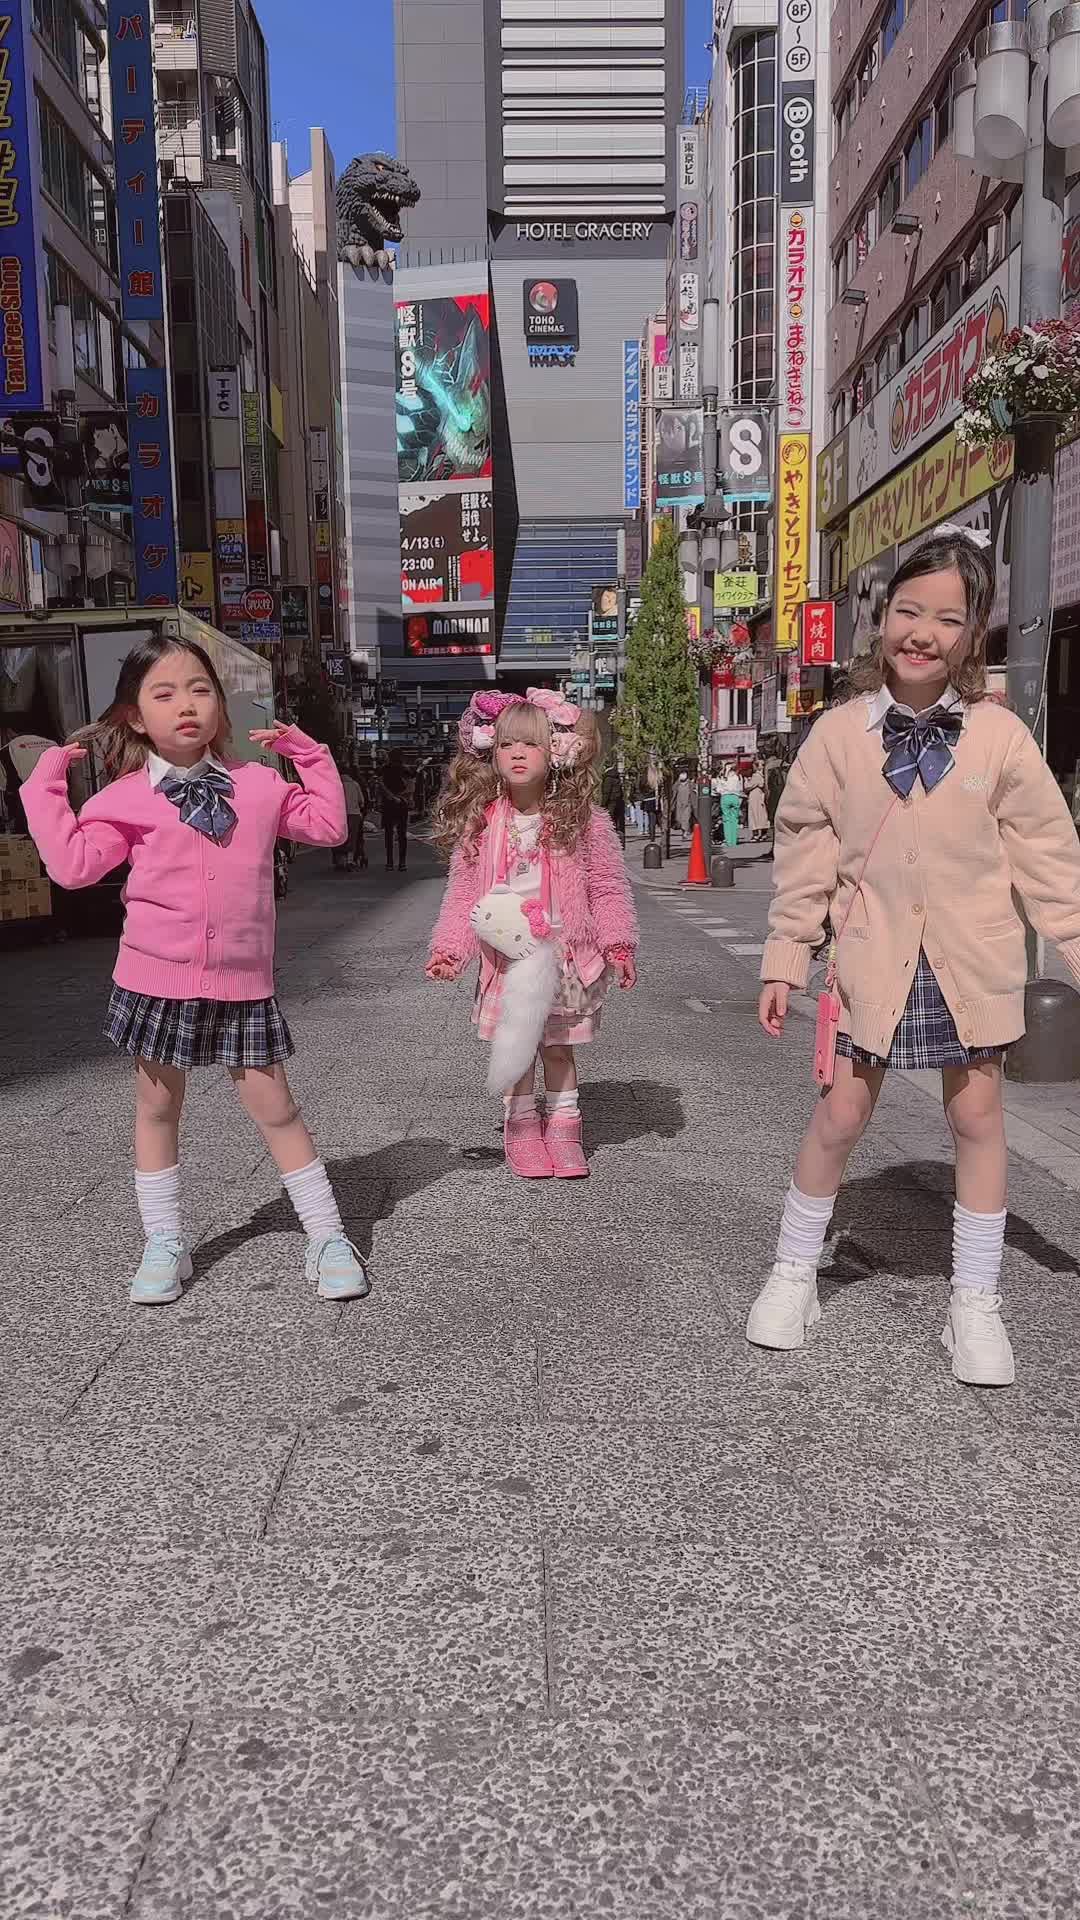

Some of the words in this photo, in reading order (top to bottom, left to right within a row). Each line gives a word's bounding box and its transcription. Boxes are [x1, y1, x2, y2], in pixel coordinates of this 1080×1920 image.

[791, 4, 807, 17] 8F
[791, 53, 807, 66] 5F
[783, 97, 813, 183] Booth
[116, 15, 155, 297] パーティー館
[684, 142, 694, 185] 東京ビル
[516, 223, 572, 239] HOTEL
[575, 222, 653, 239] GRACERY
[787, 228, 806, 303] カラオケ
[529, 316, 555, 324] TOHO
[529, 325, 565, 333] CINEMAS
[397, 304, 418, 400] 怪獣8号
[528, 345, 575, 361] IMAX
[625, 348, 638, 393] 747
[787, 323, 807, 426] まねきねこ
[904, 310, 987, 435] カラオケ
[820, 442, 844, 513] 3F
[136, 391, 169, 605] カラオケ
[461, 493, 492, 510] 怪獣を、
[868, 446, 985, 553] やきとりセンター
[461, 510, 480, 527] 討伐
[462, 530, 488, 543] せよ。
[402, 558, 434, 571] 23:00
[783, 470, 802, 640] やきとりセンター
[402, 579, 416, 591] ON
[419, 578, 437, 590] AIR
[722, 576, 748, 588] 雀荘
[433, 617, 489, 635] MARUHAN
[810, 621, 827, 657] 焼肉
